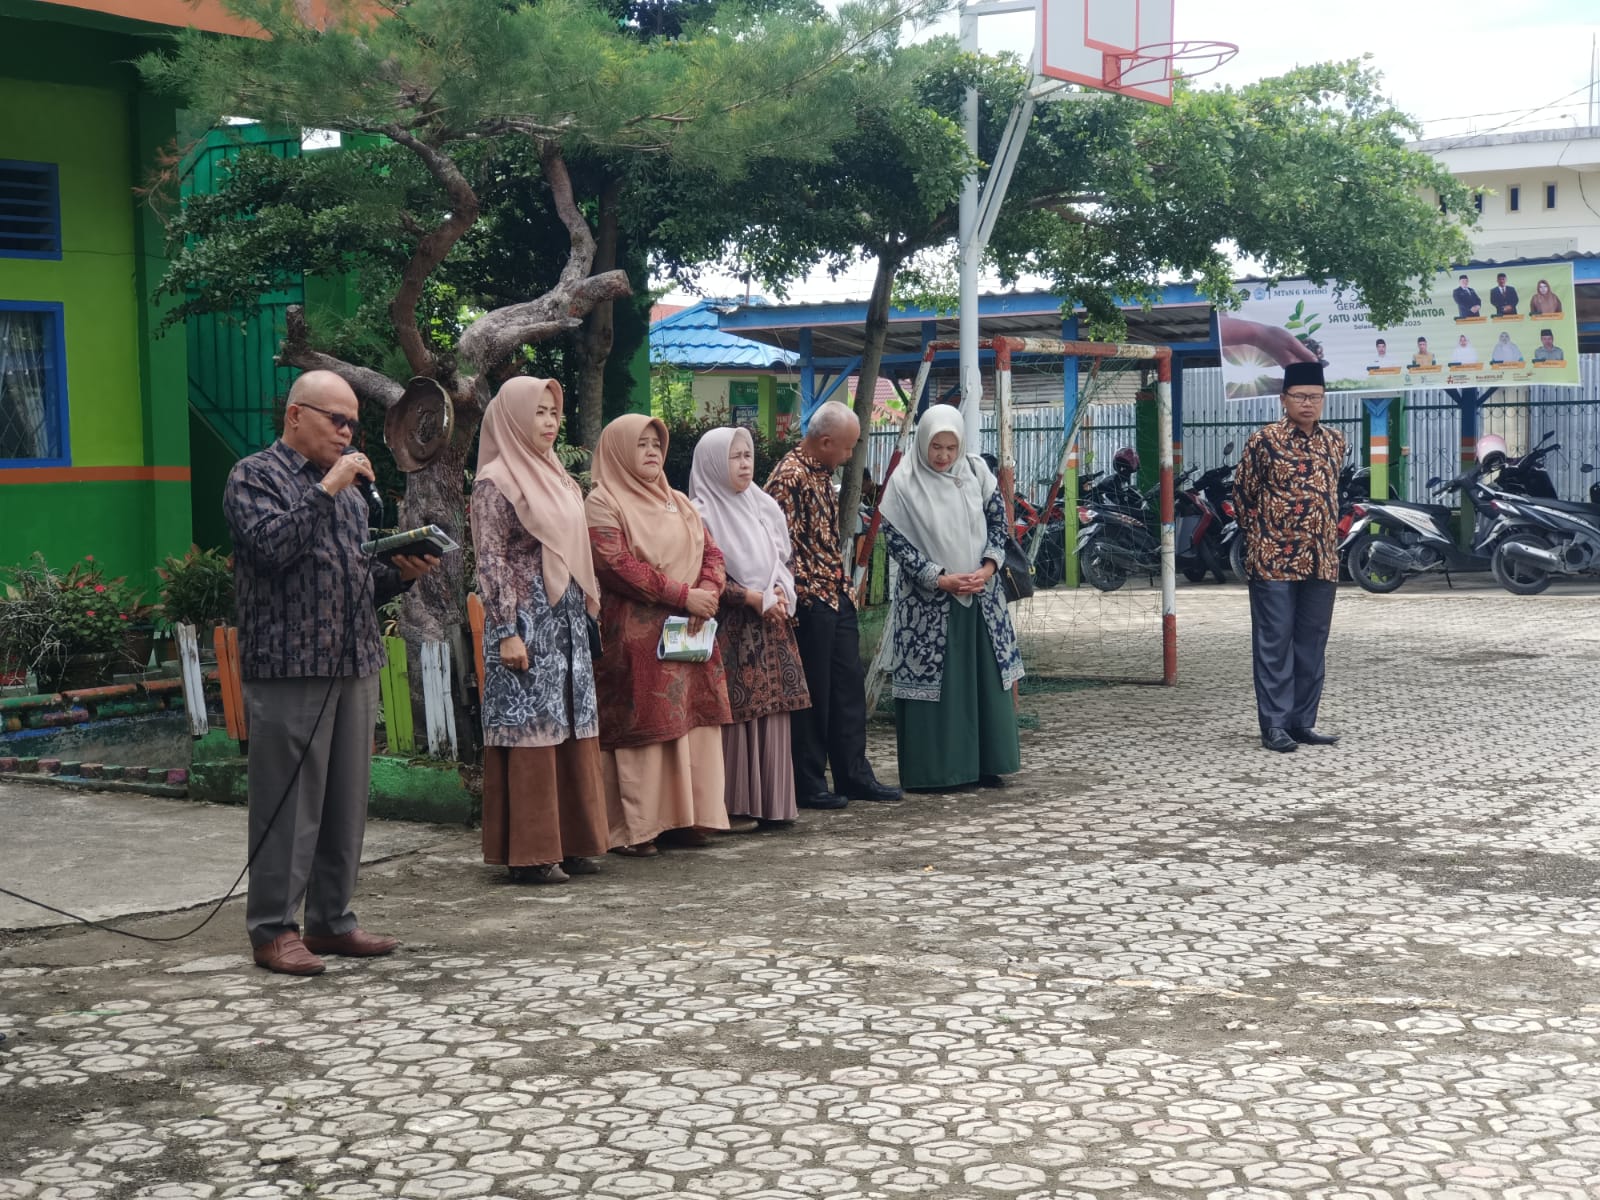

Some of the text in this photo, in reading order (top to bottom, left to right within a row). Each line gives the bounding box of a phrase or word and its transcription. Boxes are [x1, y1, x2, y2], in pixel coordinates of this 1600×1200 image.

[1302, 286, 1328, 296] Kerinci
[1328, 313, 1350, 323] SATU
[1352, 312, 1370, 322] JUT
[1411, 308, 1445, 318] MATOA
